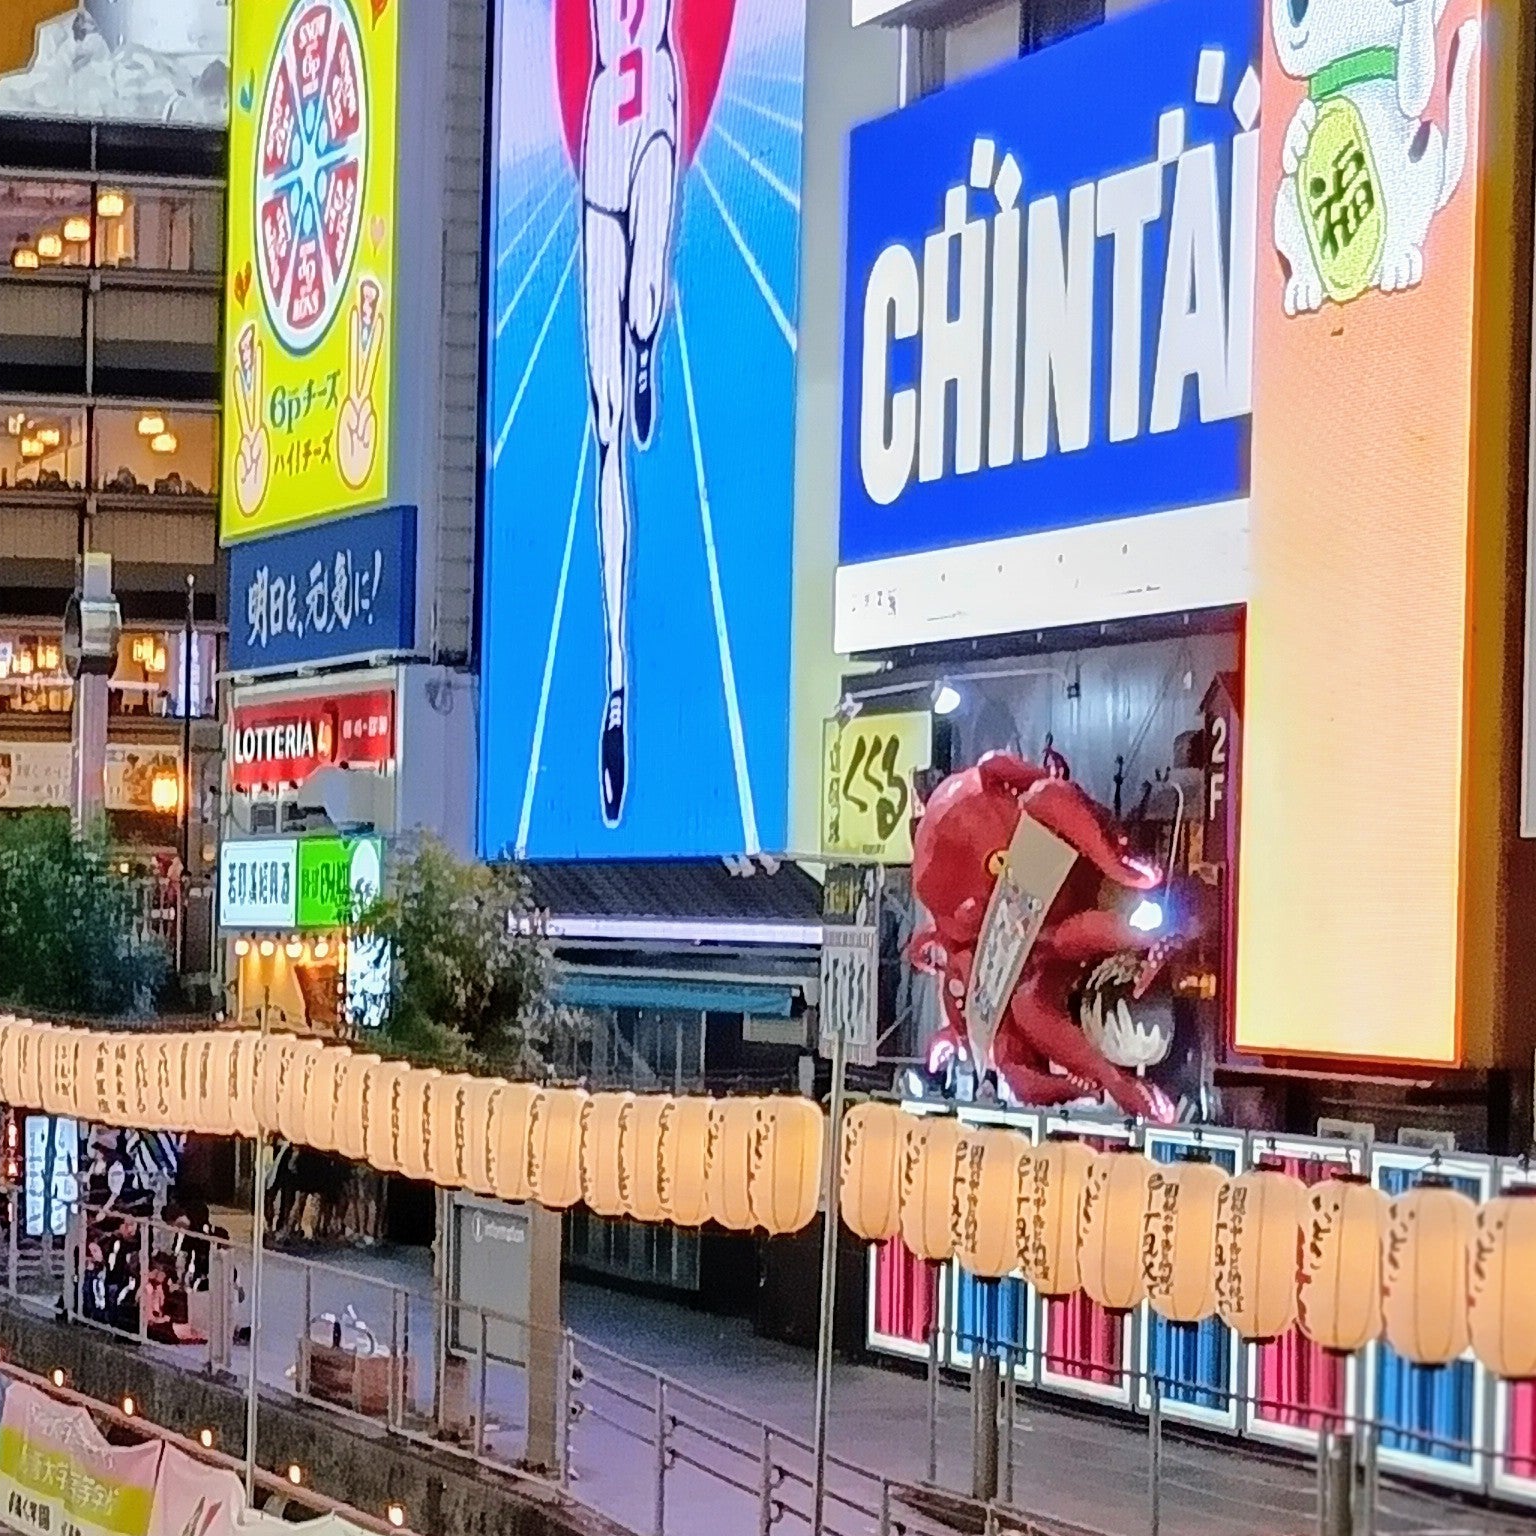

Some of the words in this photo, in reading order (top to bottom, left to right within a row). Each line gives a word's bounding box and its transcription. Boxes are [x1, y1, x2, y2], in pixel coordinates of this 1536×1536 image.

[235, 719, 314, 765] LOTTERIA
[843, 734, 907, 841] くくる
